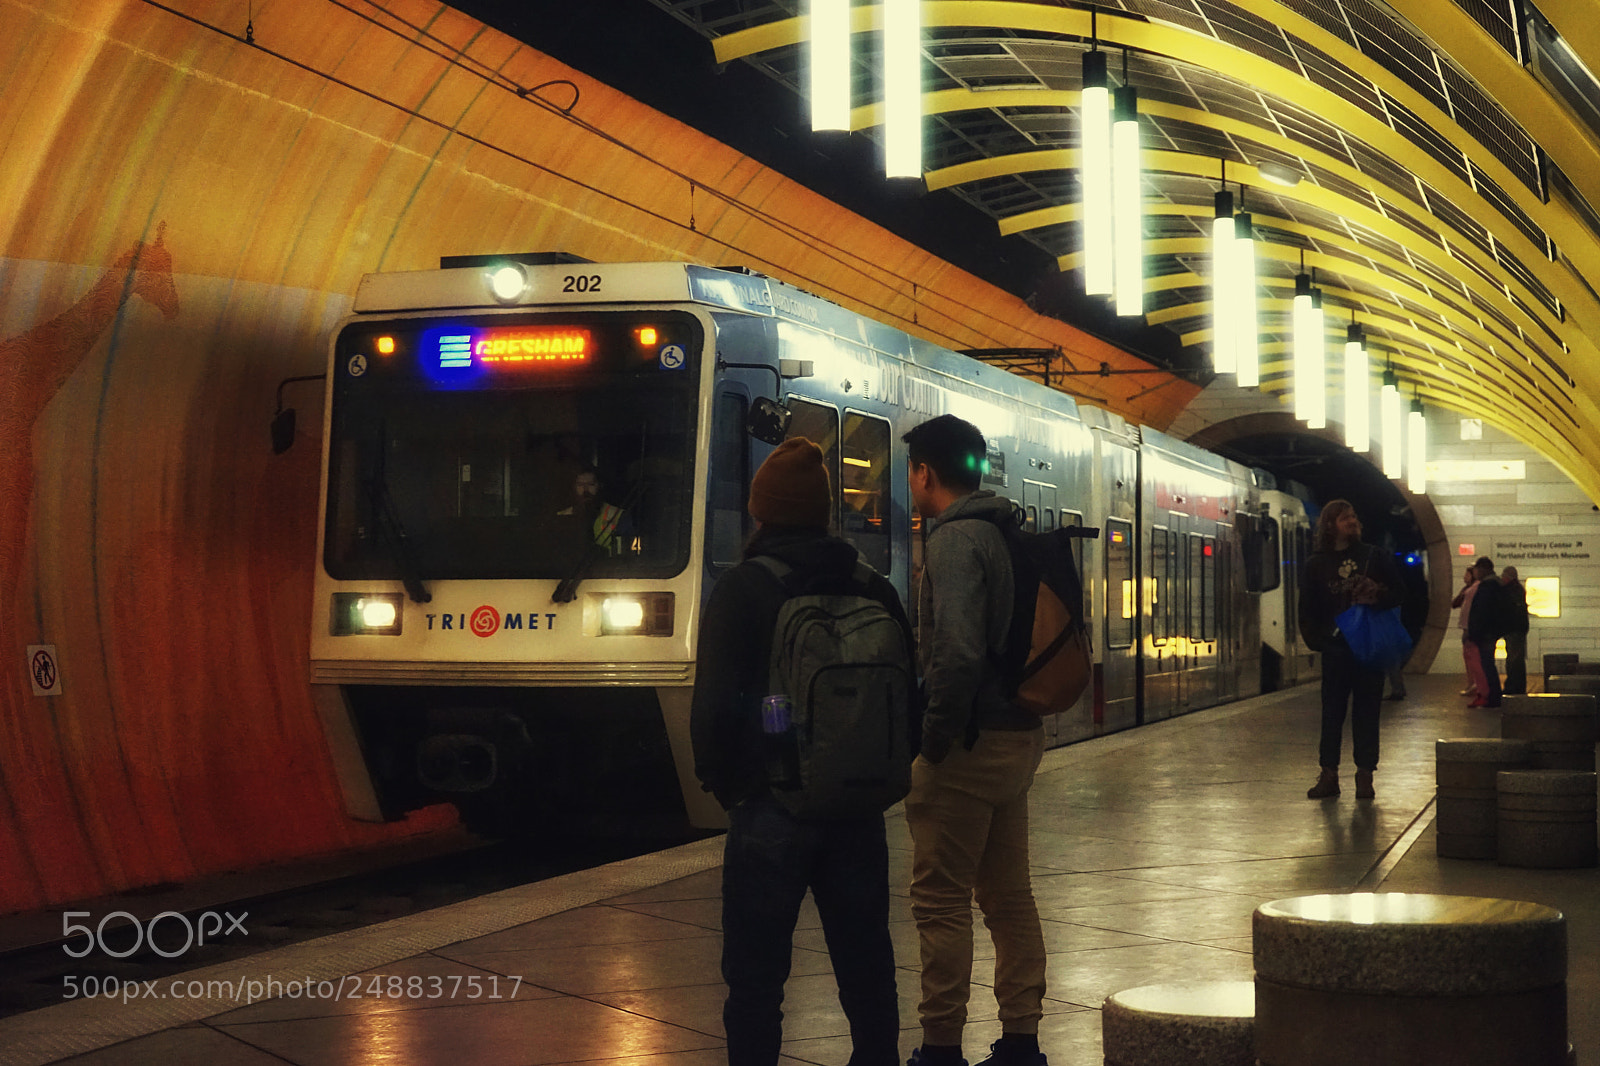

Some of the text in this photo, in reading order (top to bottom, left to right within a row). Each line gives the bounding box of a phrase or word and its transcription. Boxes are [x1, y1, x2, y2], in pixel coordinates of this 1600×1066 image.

[563, 275, 602, 292] 202
[475, 336, 586, 362] GRESHAM
[426, 613, 557, 630] TRI MET
